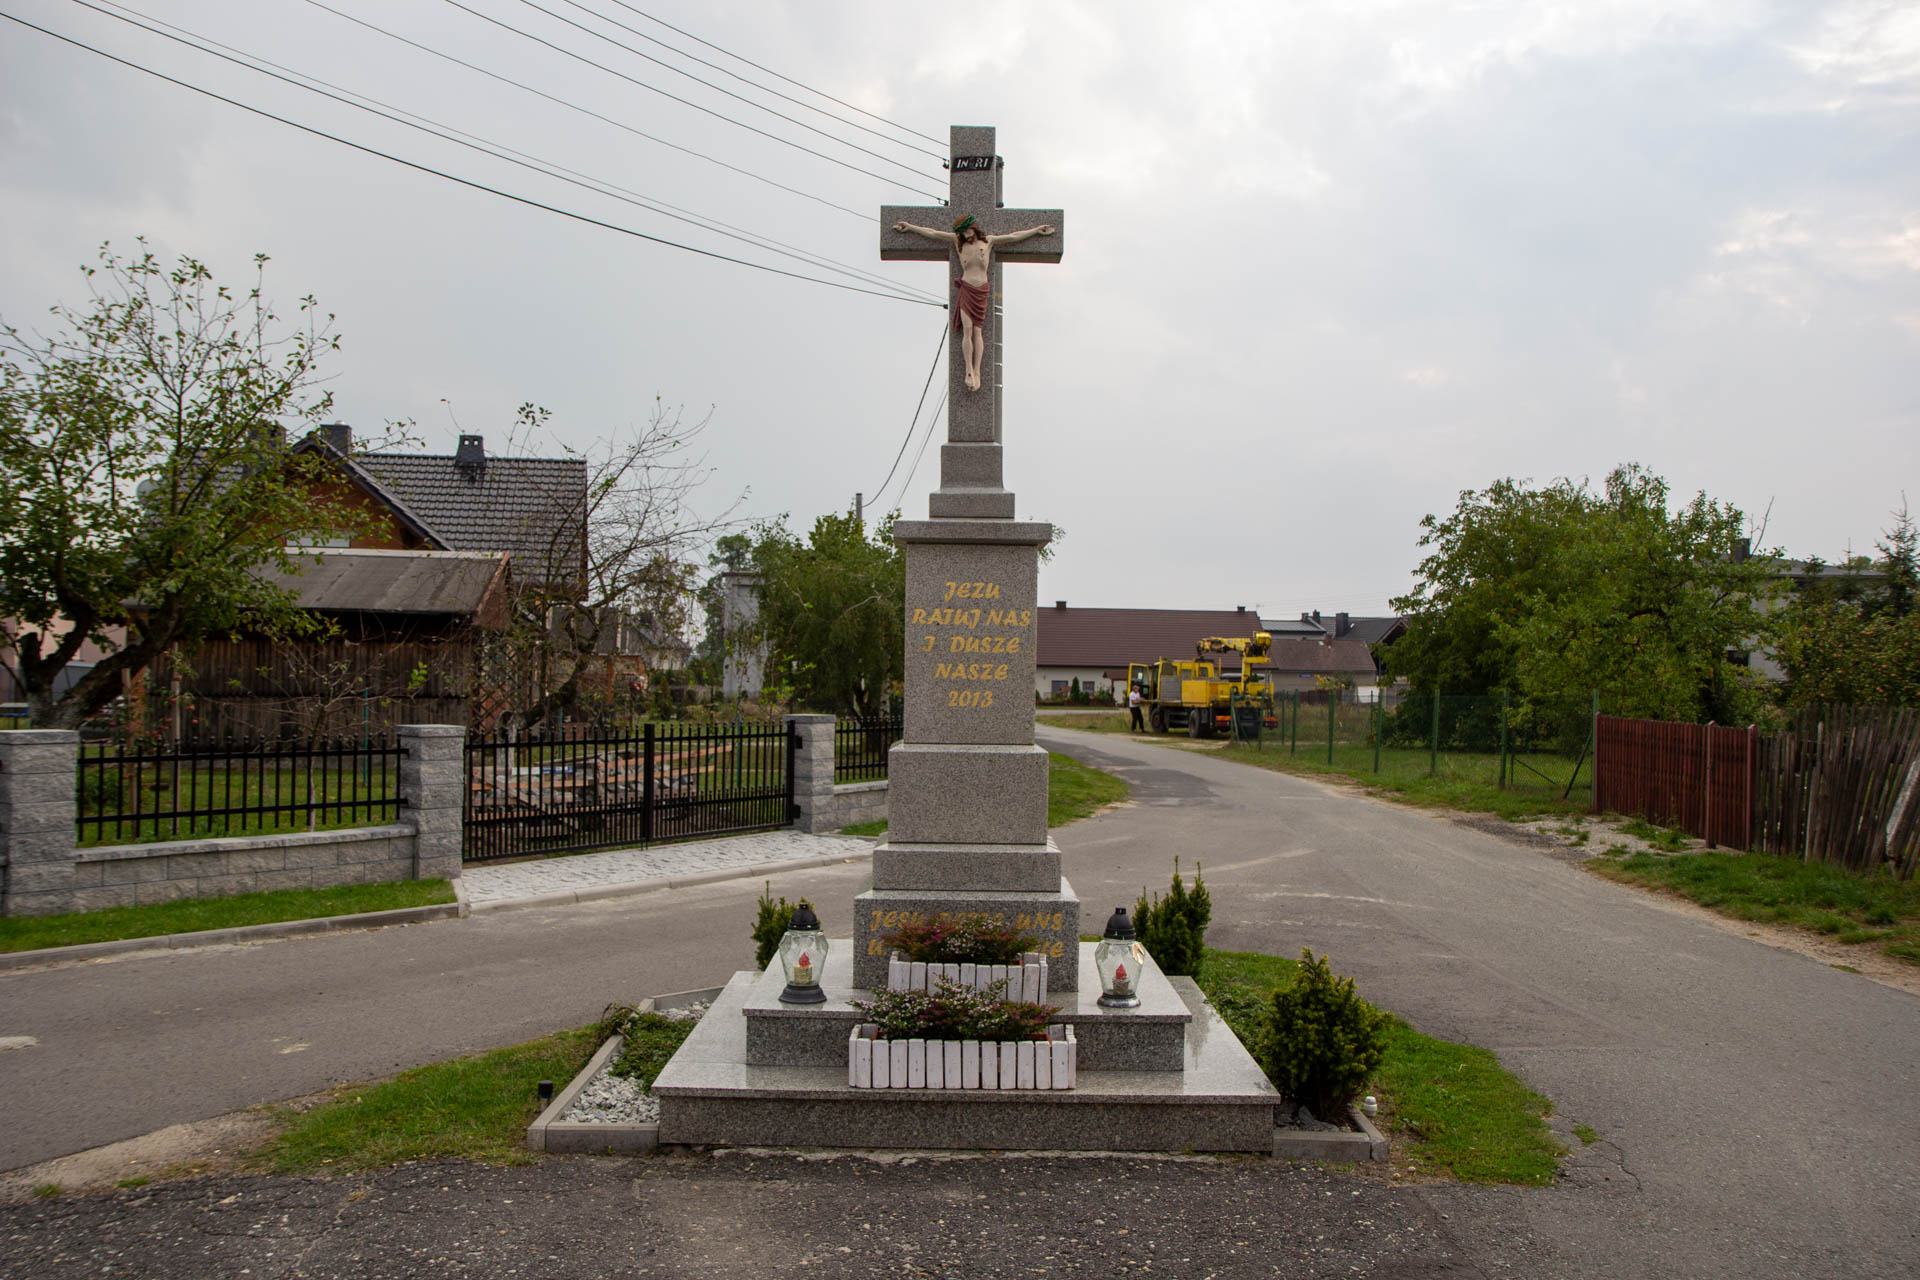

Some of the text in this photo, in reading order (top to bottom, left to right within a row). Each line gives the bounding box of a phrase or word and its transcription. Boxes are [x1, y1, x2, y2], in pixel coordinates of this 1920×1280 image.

[944, 581, 1000, 601] JEZU
[912, 608, 1032, 630] RATUJ NAS
[950, 635, 1021, 653] DUSZE
[934, 663, 1009, 680] NASZE
[948, 690, 993, 708] 2013
[870, 910, 925, 931] JESU
[1016, 911, 1064, 931] UNS
